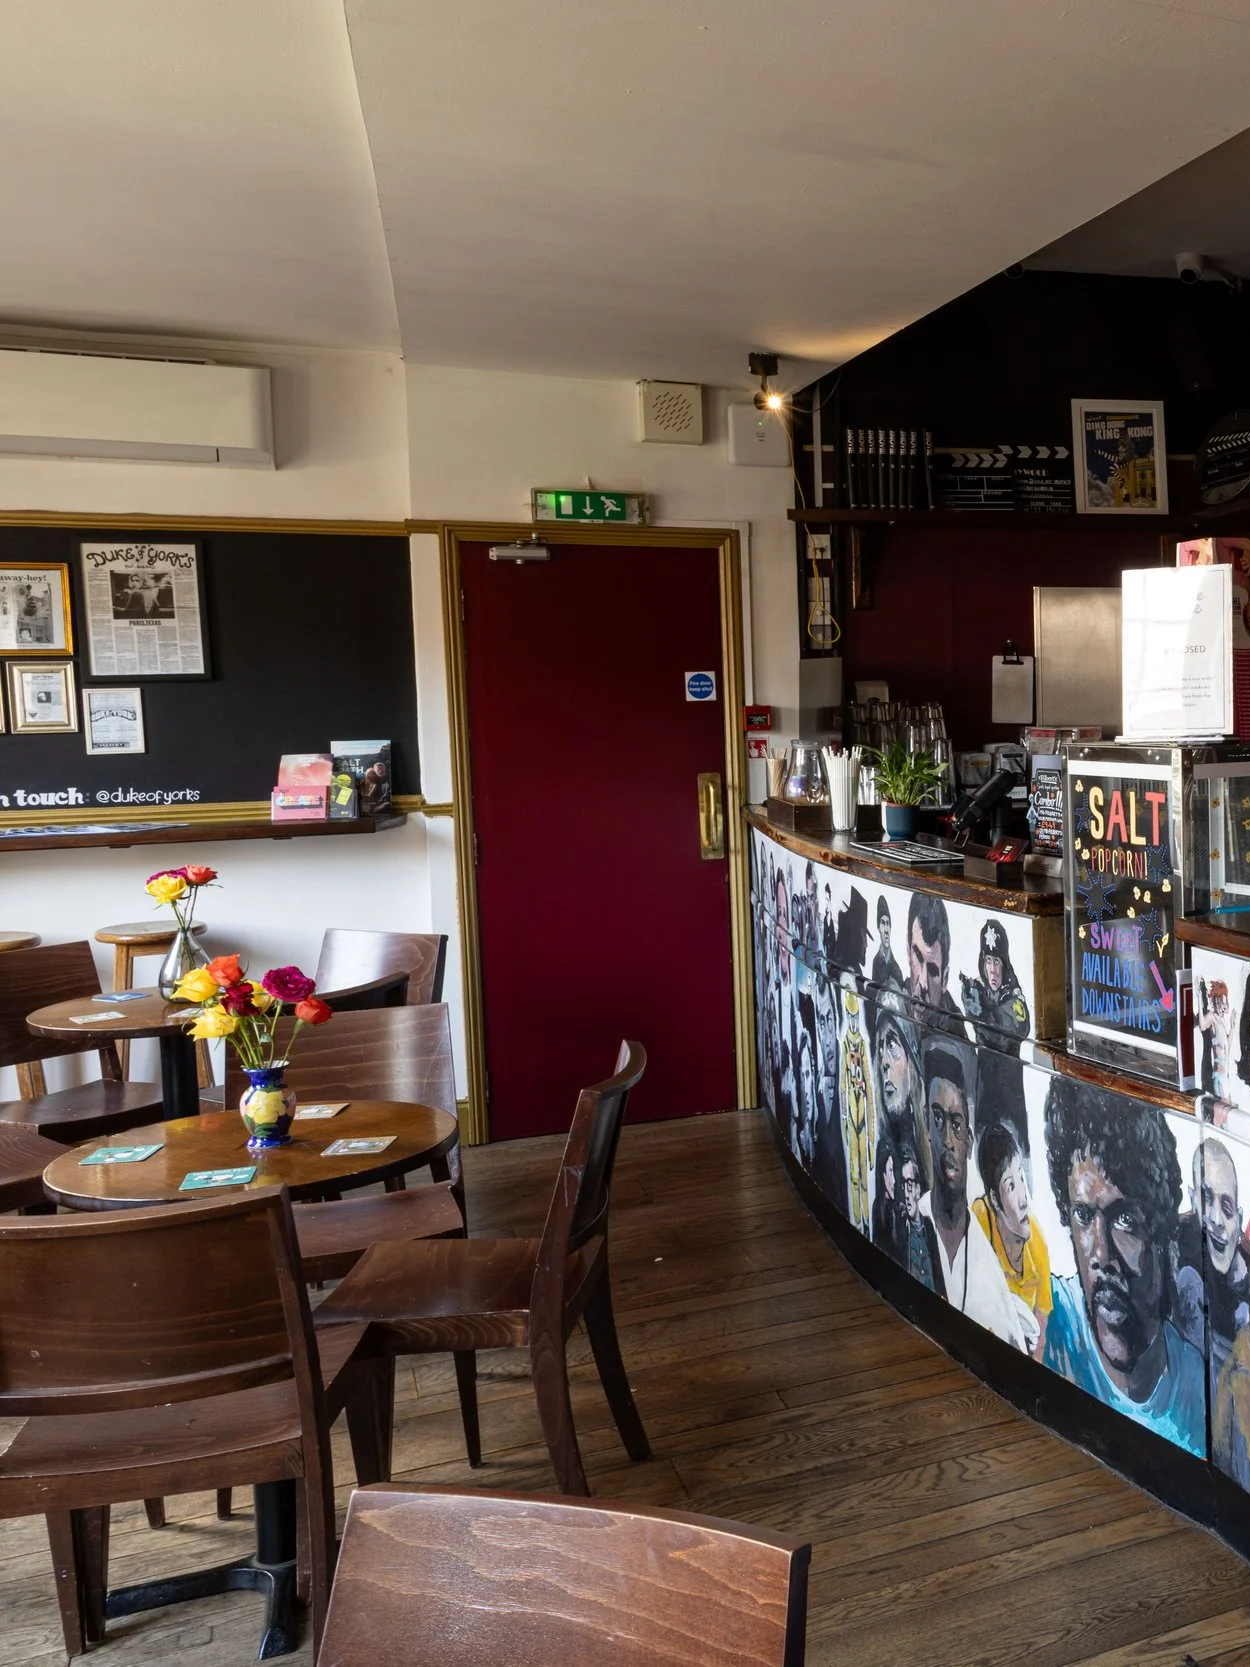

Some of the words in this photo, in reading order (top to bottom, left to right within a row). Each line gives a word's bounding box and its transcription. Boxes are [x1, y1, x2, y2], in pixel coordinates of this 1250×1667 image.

[1086, 421, 1106, 431] DING
[1095, 428, 1121, 440] KING
[1127, 426, 1154, 438] KONG
[86, 548, 134, 567] DUKE
[147, 547, 194, 569] YORK'S
[96, 787, 200, 805] @dukeofyorks
[1089, 786, 1166, 847] SALT
[1091, 847, 1148, 881] POPCORN!
[1090, 924, 1143, 954] SWEET
[1082, 952, 1145, 993] AVAILABLE
[1082, 987, 1162, 1034] DOWNSTAIRS
